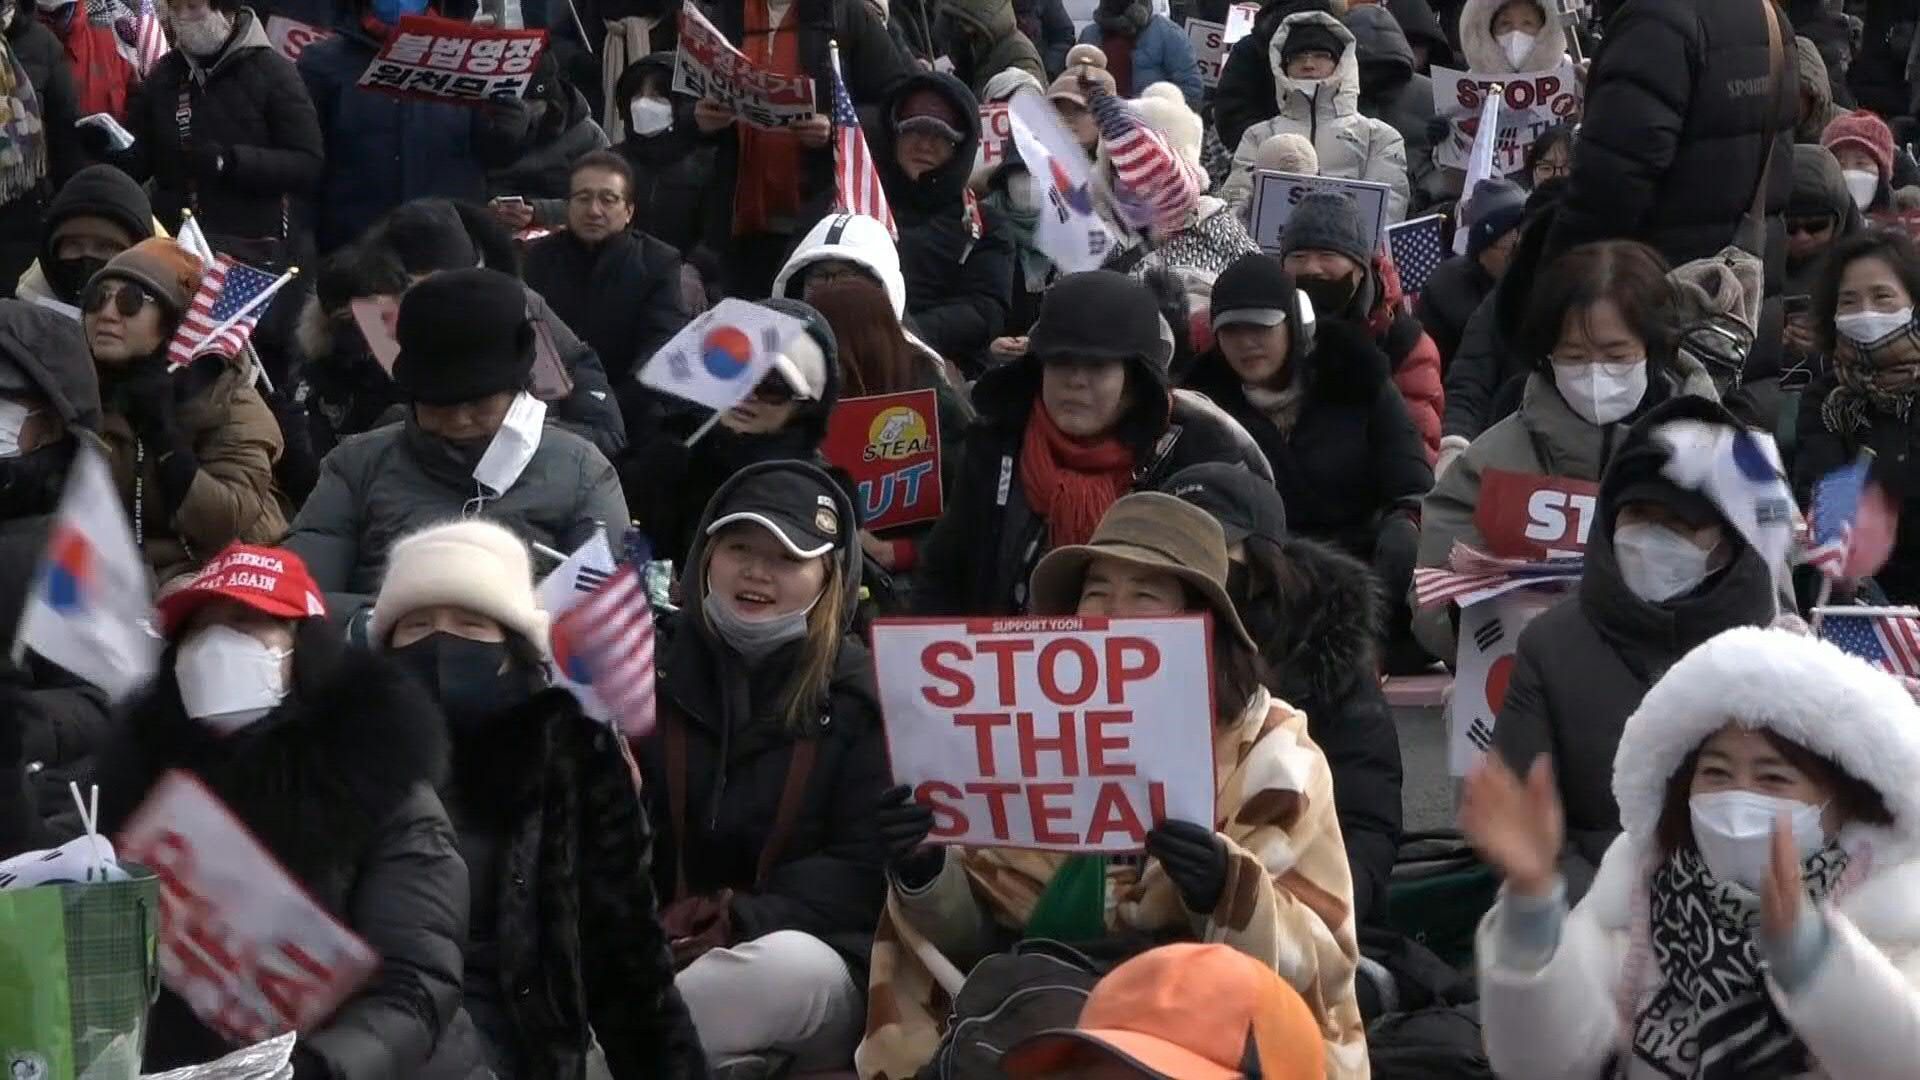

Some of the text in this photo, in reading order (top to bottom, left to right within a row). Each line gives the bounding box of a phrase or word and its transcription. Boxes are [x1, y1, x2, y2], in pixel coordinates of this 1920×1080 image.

[1456, 76, 1561, 110] STOP
[863, 437, 933, 460] STEAL
[858, 460, 933, 521] UT
[1525, 490, 1597, 544] ST
[223, 553, 284, 574] AMERICA
[226, 571, 277, 592] AGAIN
[992, 618, 1083, 633] SUPPORT YOON
[921, 637, 1161, 708] STOP
[953, 710, 1137, 777] THE
